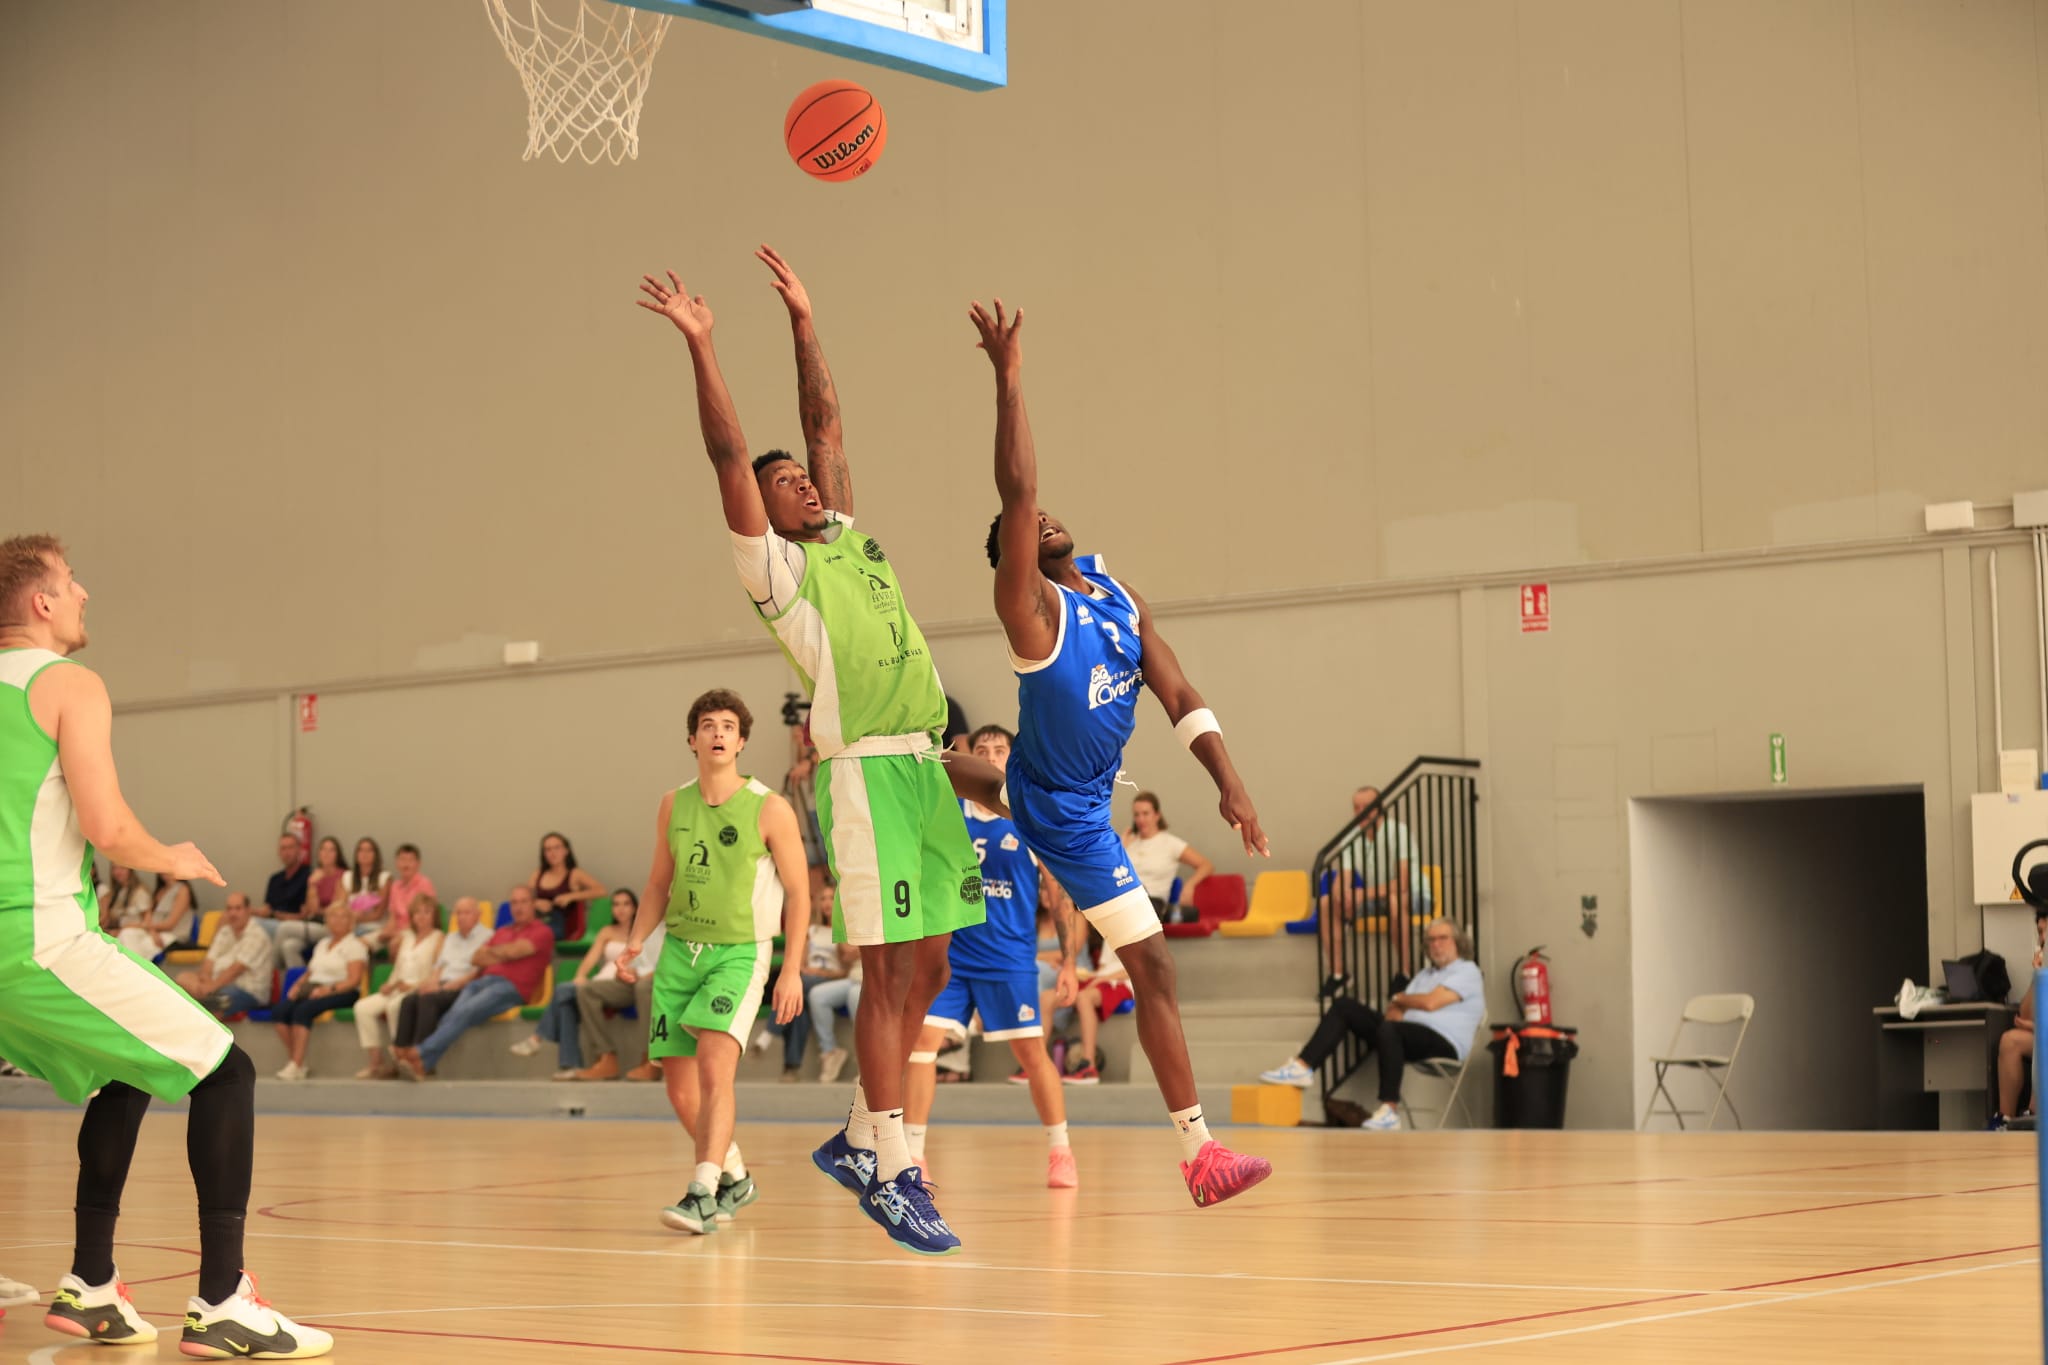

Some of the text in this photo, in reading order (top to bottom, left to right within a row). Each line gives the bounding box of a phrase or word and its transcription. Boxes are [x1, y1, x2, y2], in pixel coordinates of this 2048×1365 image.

[812, 123, 874, 169] Wilson
[893, 880, 911, 918] 9
[982, 883, 1012, 899] nida
